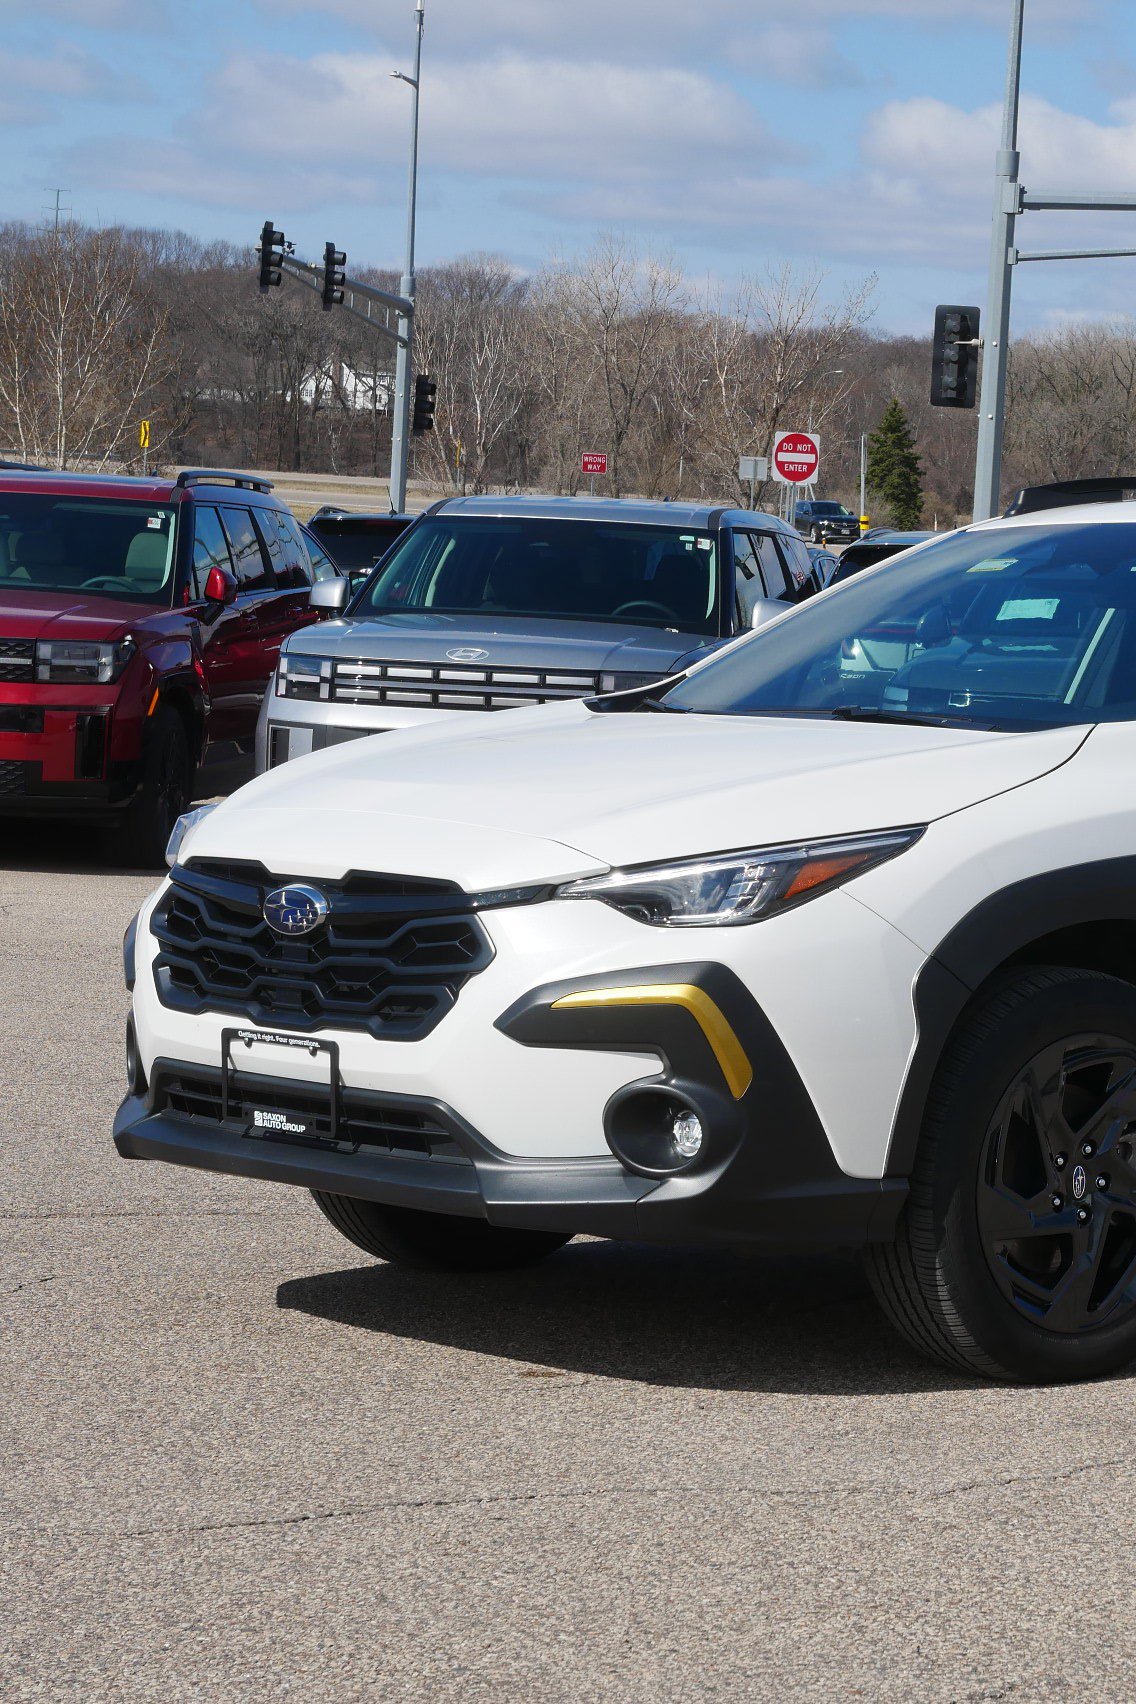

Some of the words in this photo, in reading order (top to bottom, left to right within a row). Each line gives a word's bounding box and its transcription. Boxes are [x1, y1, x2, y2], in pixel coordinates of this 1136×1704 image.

[782, 442, 793, 451] DO
[796, 443, 812, 452] NOT
[784, 463, 808, 472] ENTER
[263, 1112, 287, 1122] SAXON
[263, 1120, 281, 1129] AUTO
[281, 1122, 306, 1133] GROUP
